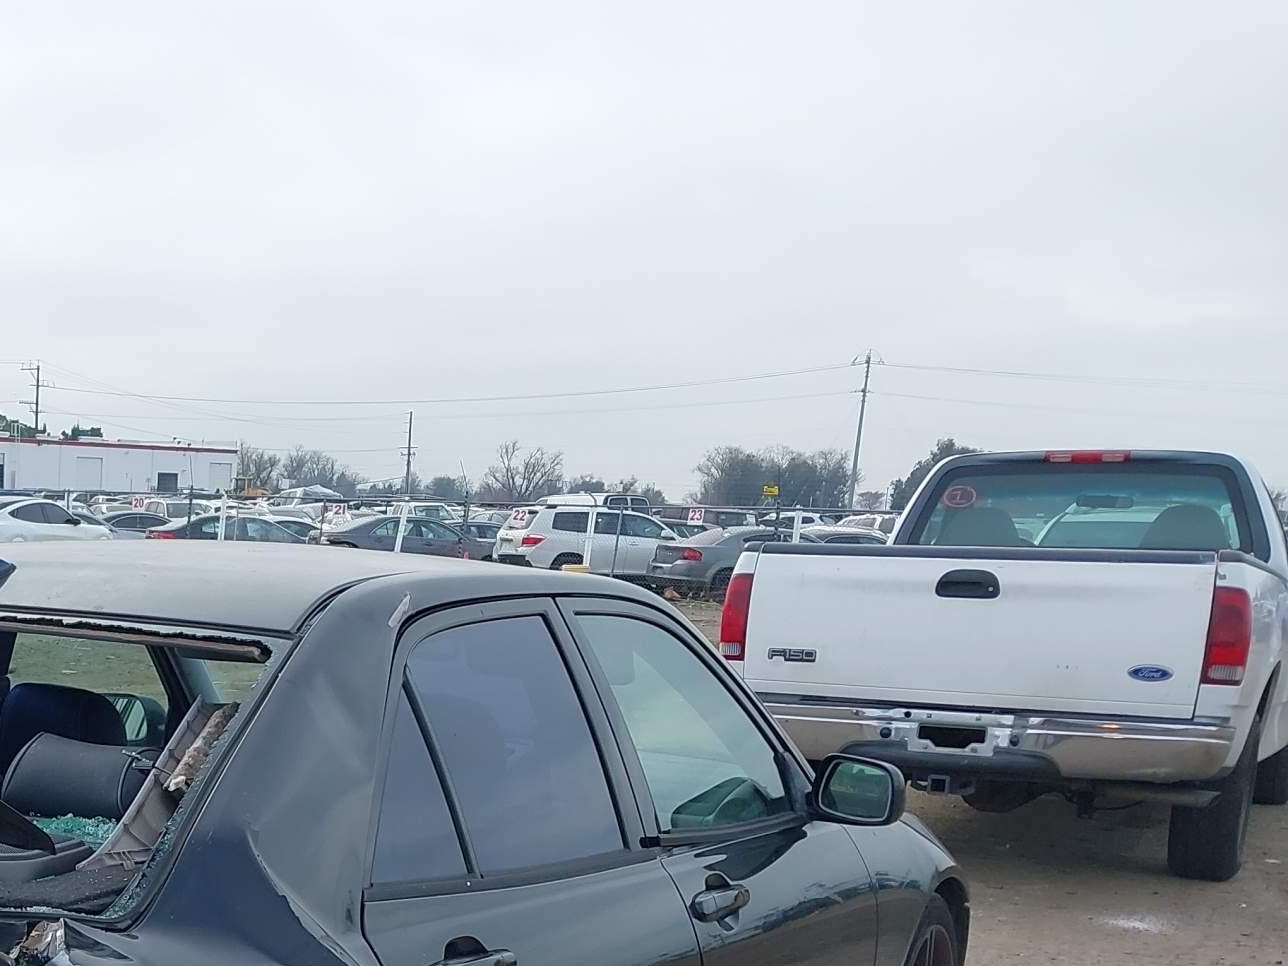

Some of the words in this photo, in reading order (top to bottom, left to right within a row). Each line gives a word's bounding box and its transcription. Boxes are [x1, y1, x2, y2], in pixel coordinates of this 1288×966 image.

[133, 498, 144, 508] 20
[334, 504, 346, 515] 21
[689, 509, 703, 521] 23
[513, 510, 527, 521] 22
